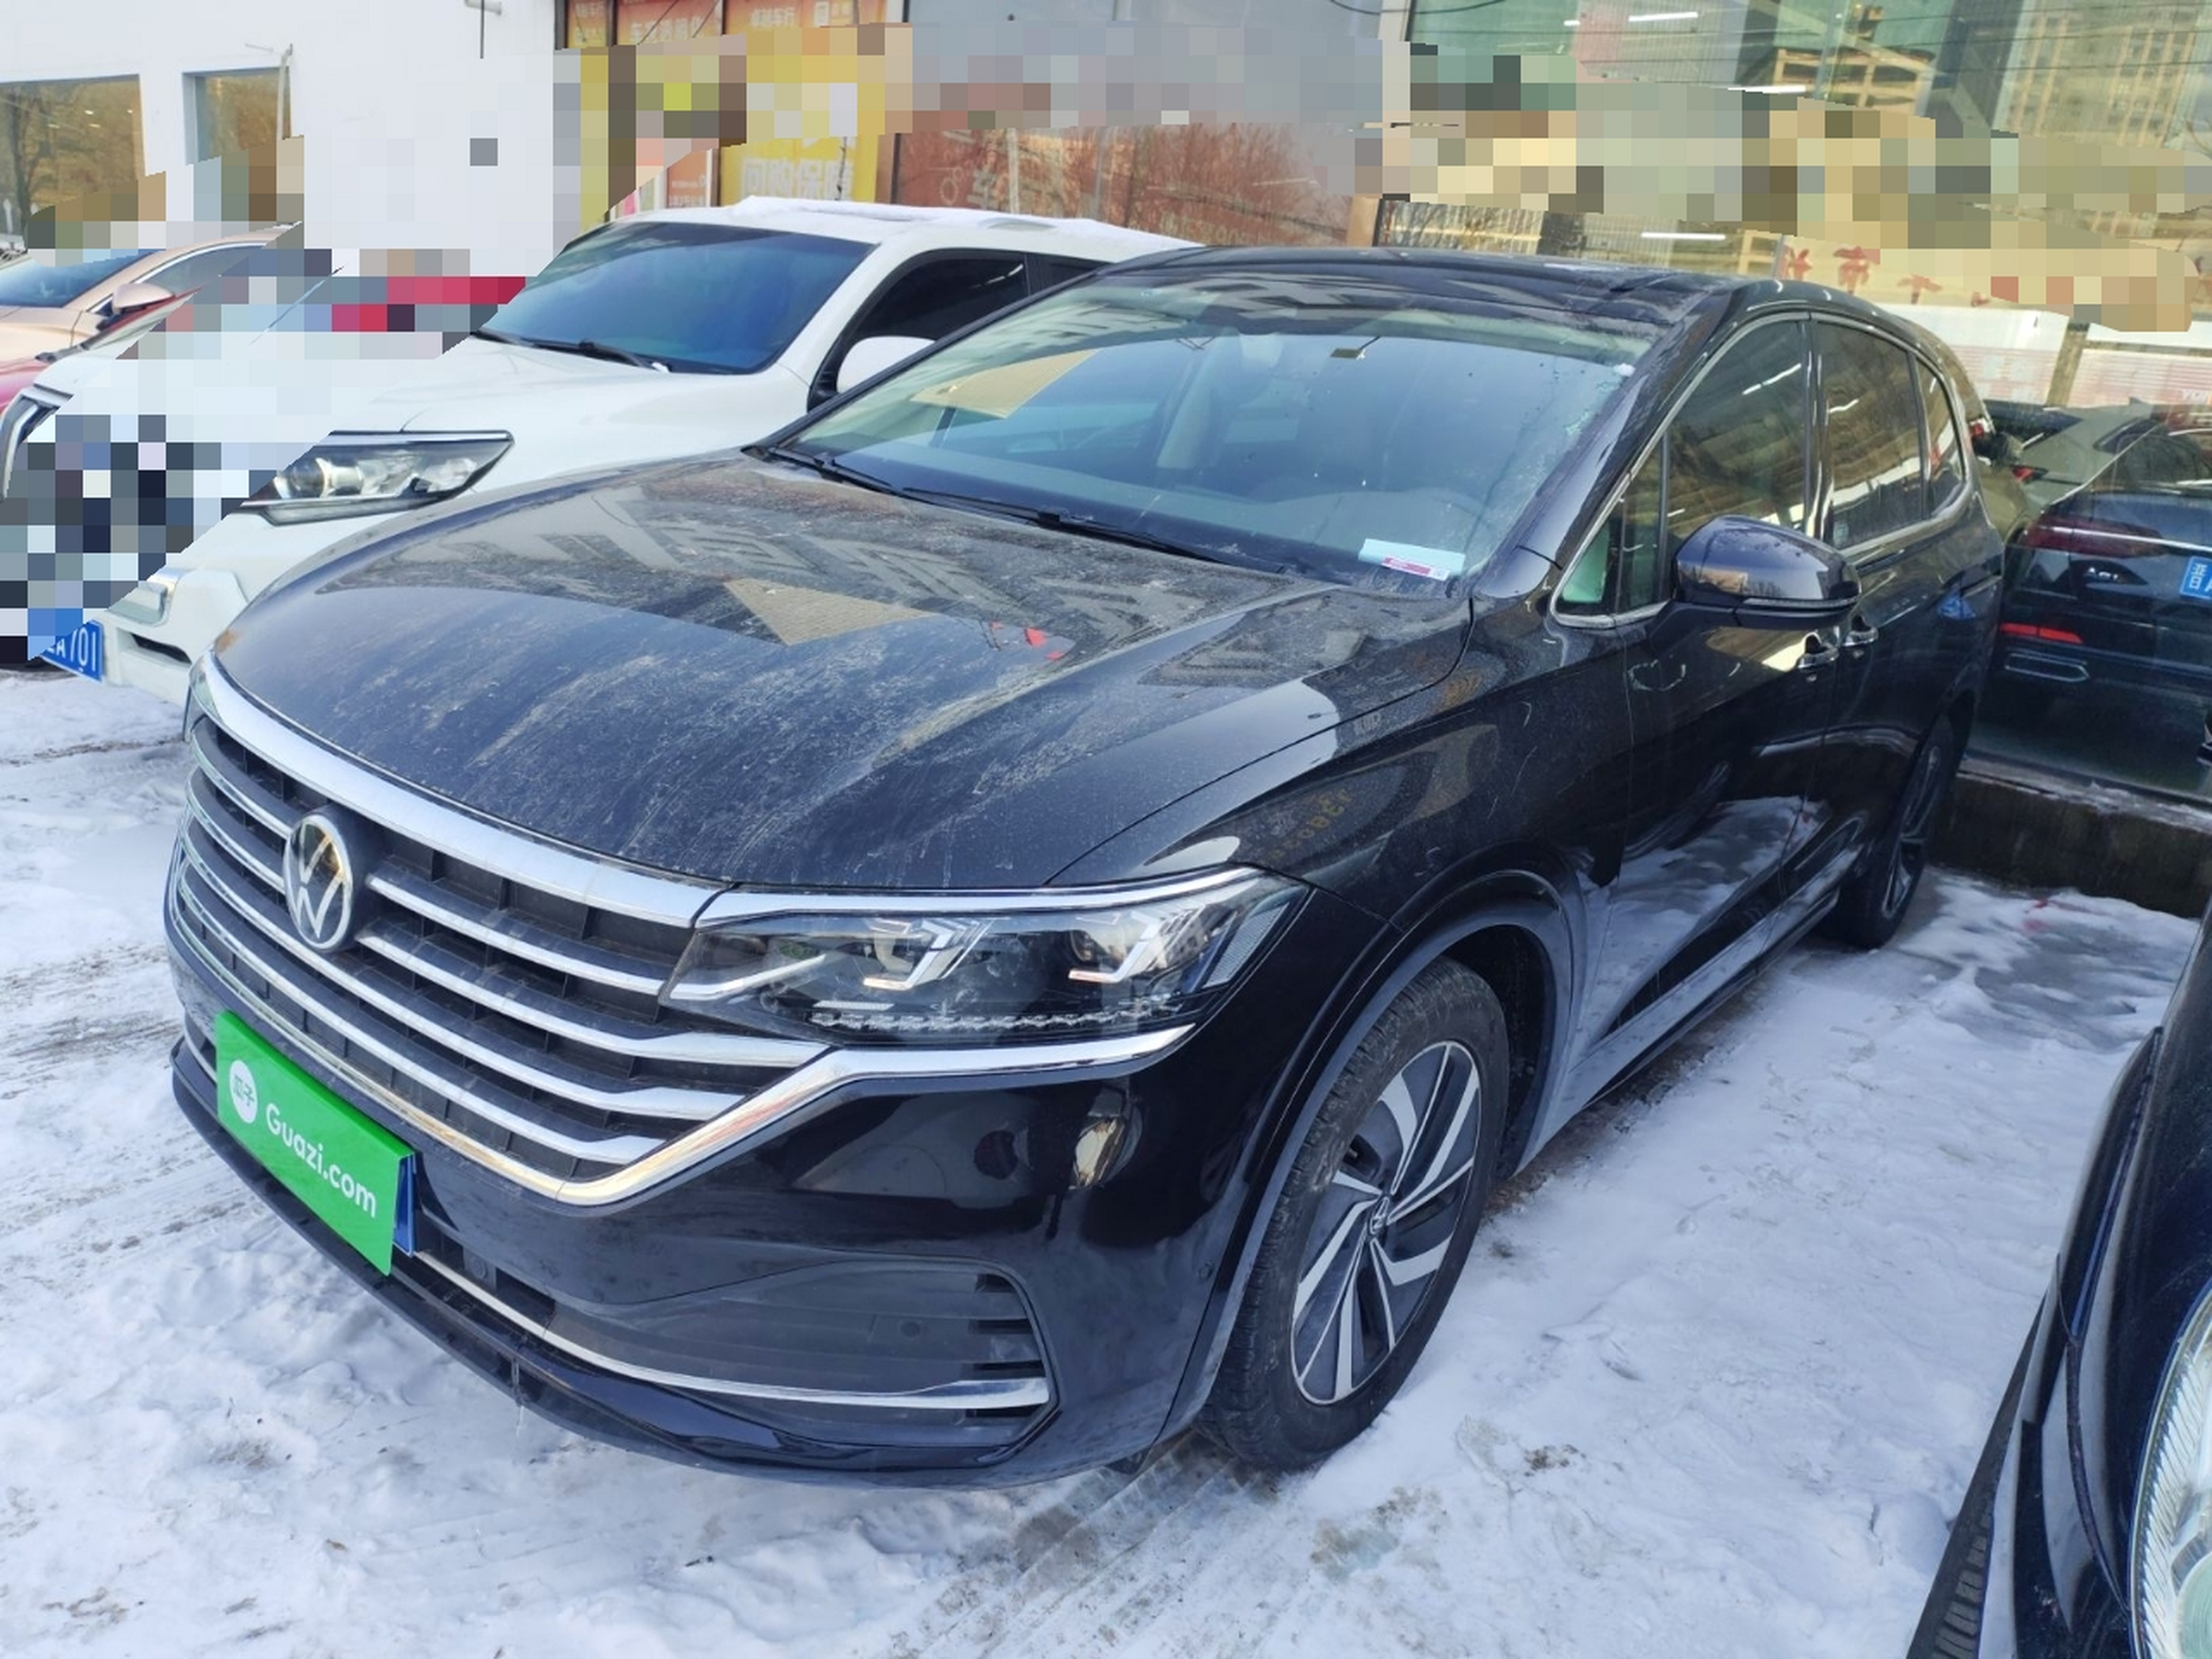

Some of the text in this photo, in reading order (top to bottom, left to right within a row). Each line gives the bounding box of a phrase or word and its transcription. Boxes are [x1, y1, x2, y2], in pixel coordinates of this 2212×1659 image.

[2190, 563, 2212, 592] 晋
[48, 627, 96, 672] A701
[266, 1103, 376, 1218] Guazi.com
